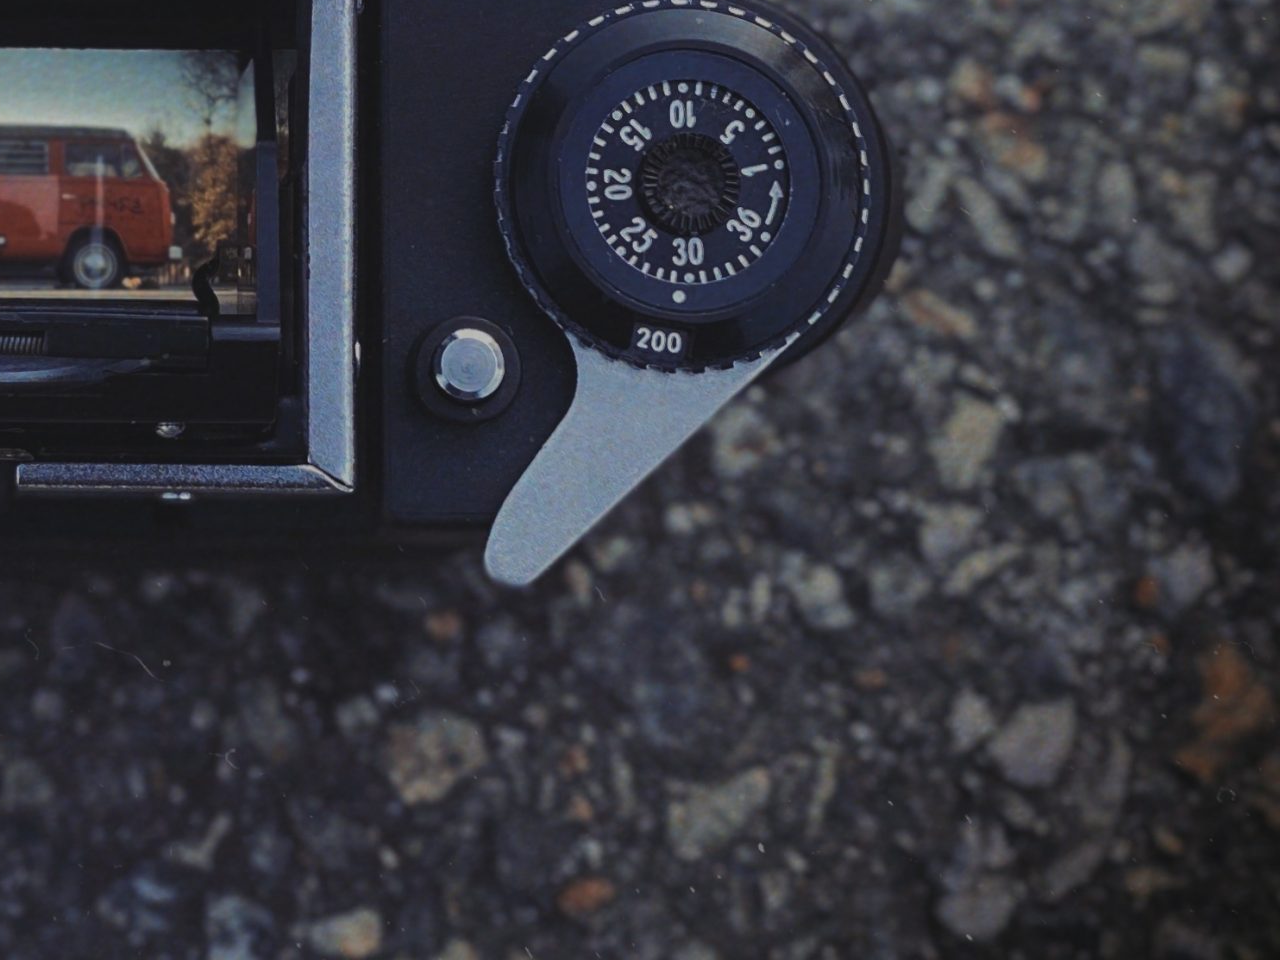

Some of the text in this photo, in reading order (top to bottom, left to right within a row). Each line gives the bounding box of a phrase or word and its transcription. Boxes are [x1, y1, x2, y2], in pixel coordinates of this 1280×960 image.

[669, 99, 696, 129] 10
[619, 118, 652, 152] 15
[719, 119, 745, 145] 5
[603, 167, 632, 201] 20
[620, 216, 658, 253] 25
[726, 206, 762, 242] 36
[672, 237, 704, 266] 30
[636, 327, 682, 354] 200
